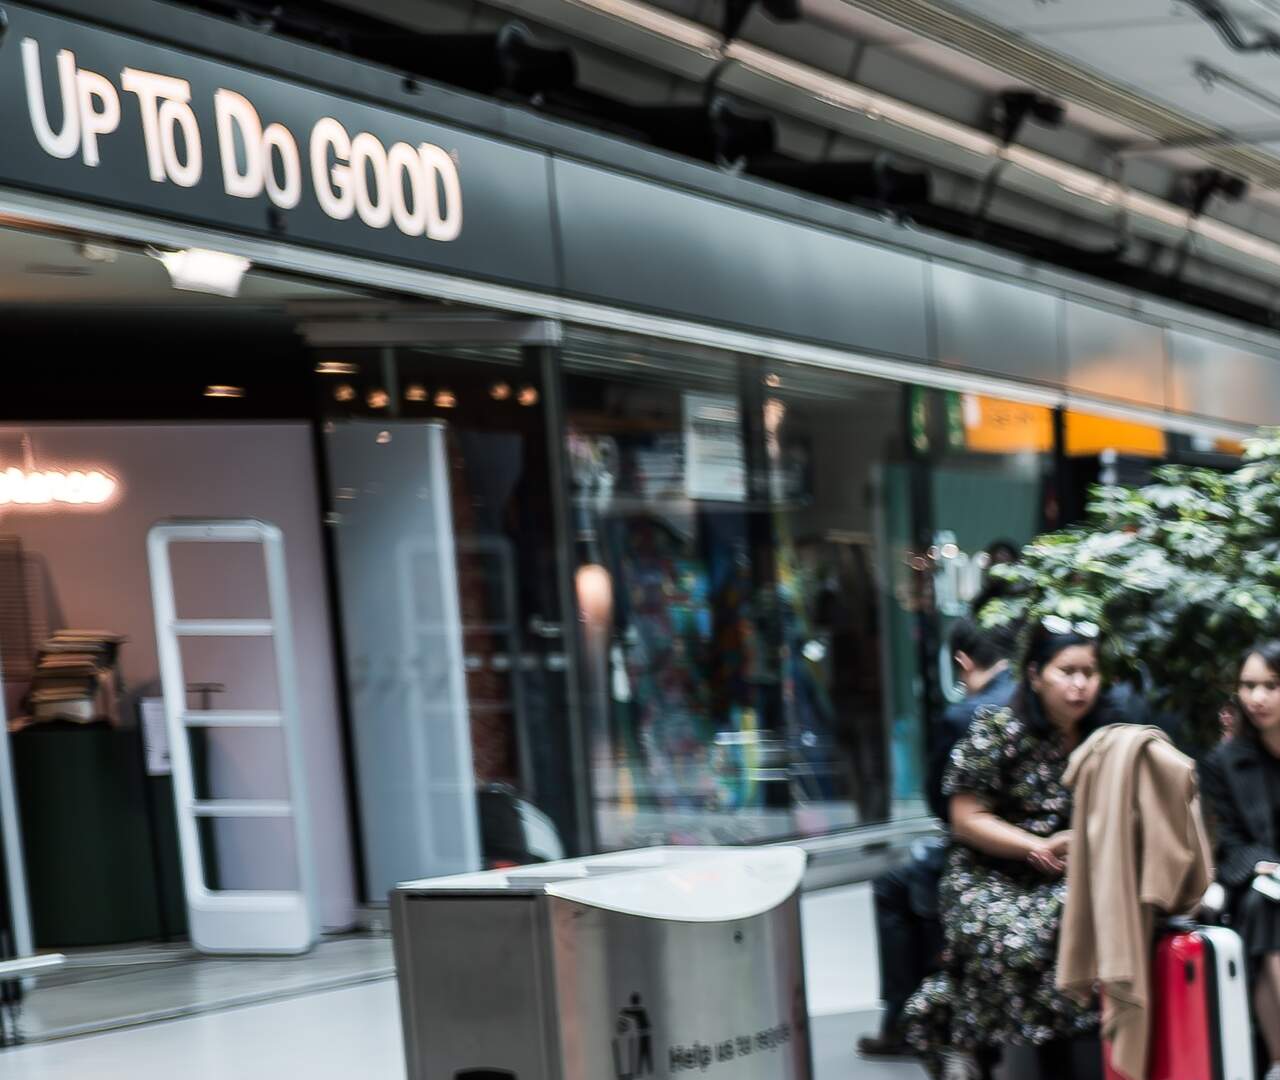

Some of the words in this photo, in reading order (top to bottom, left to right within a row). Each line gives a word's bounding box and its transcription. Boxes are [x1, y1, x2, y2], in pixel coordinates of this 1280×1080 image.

[309, 116, 462, 242] GOOD
[669, 1040, 712, 1073] Help
[715, 1039, 734, 1062] us
[735, 1035, 752, 1056] to
